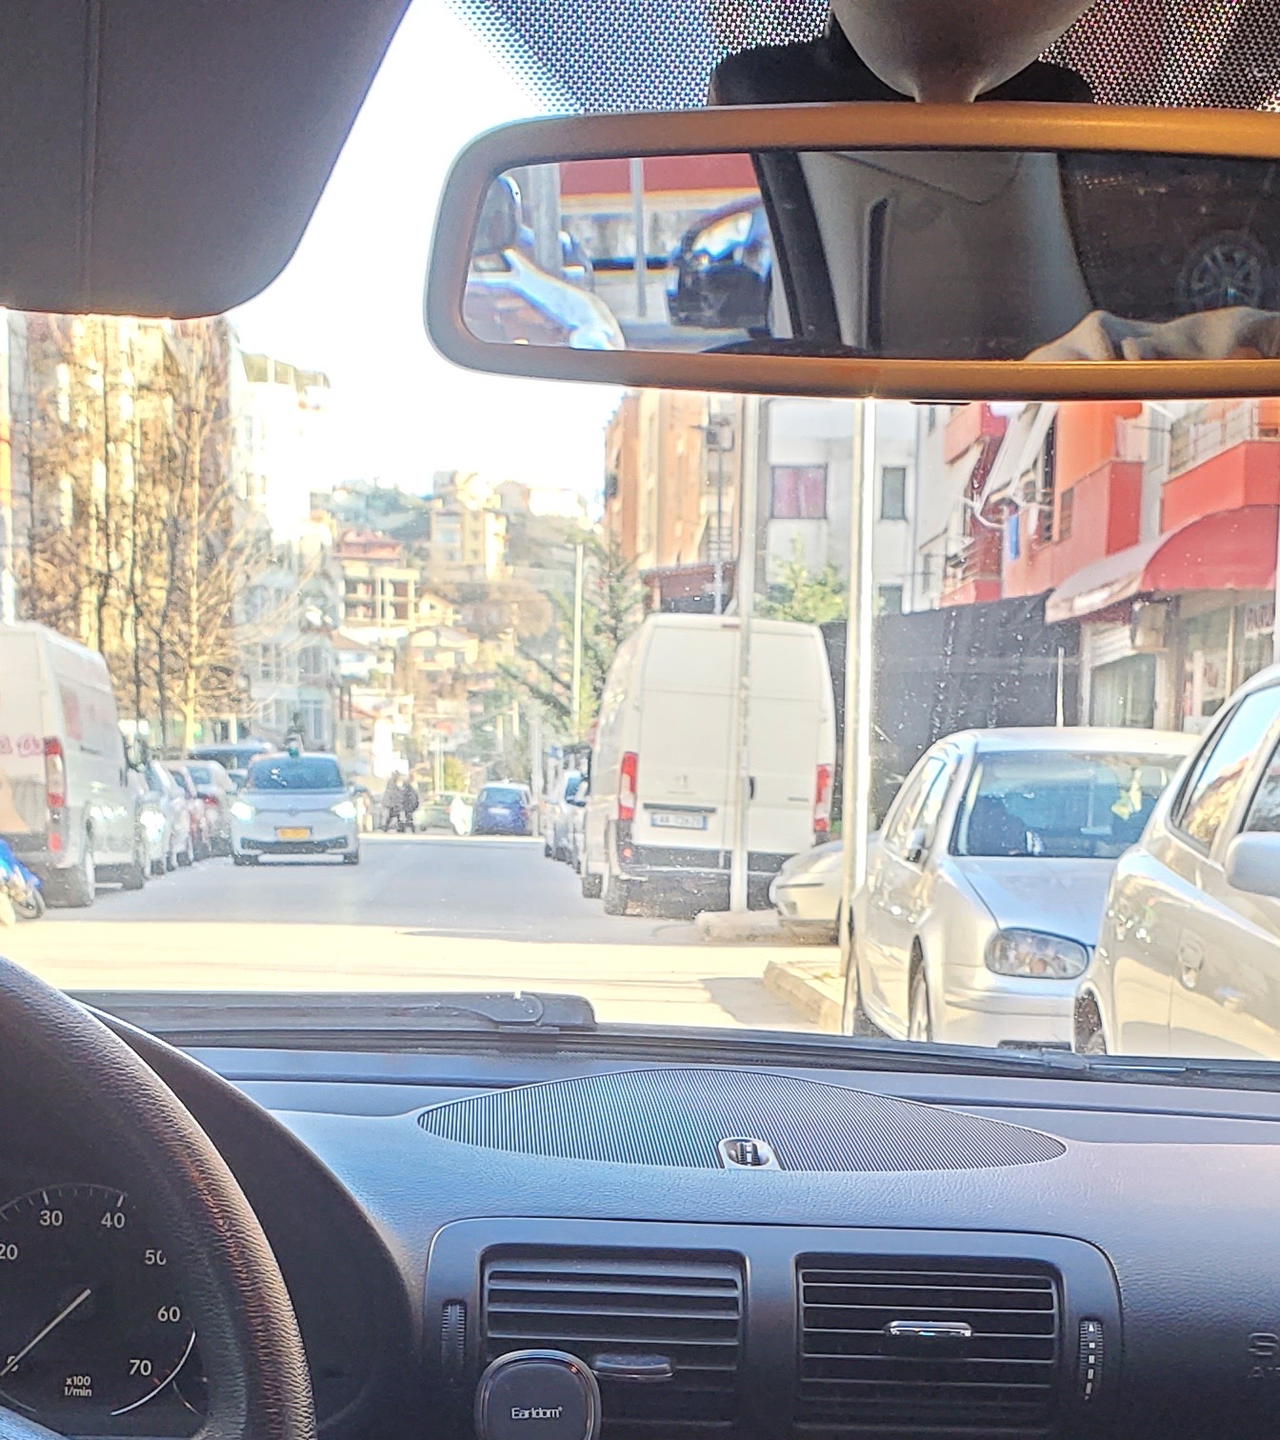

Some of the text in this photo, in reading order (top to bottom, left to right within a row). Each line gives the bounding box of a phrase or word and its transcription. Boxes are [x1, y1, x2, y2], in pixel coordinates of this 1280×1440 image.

[39, 1210, 63, 1227] 30
[101, 1212, 125, 1229] 40
[144, 1249, 167, 1266] 50
[157, 1305, 181, 1322] 60
[129, 1358, 152, 1377] 70
[511, 1407, 560, 1419] Earldom
